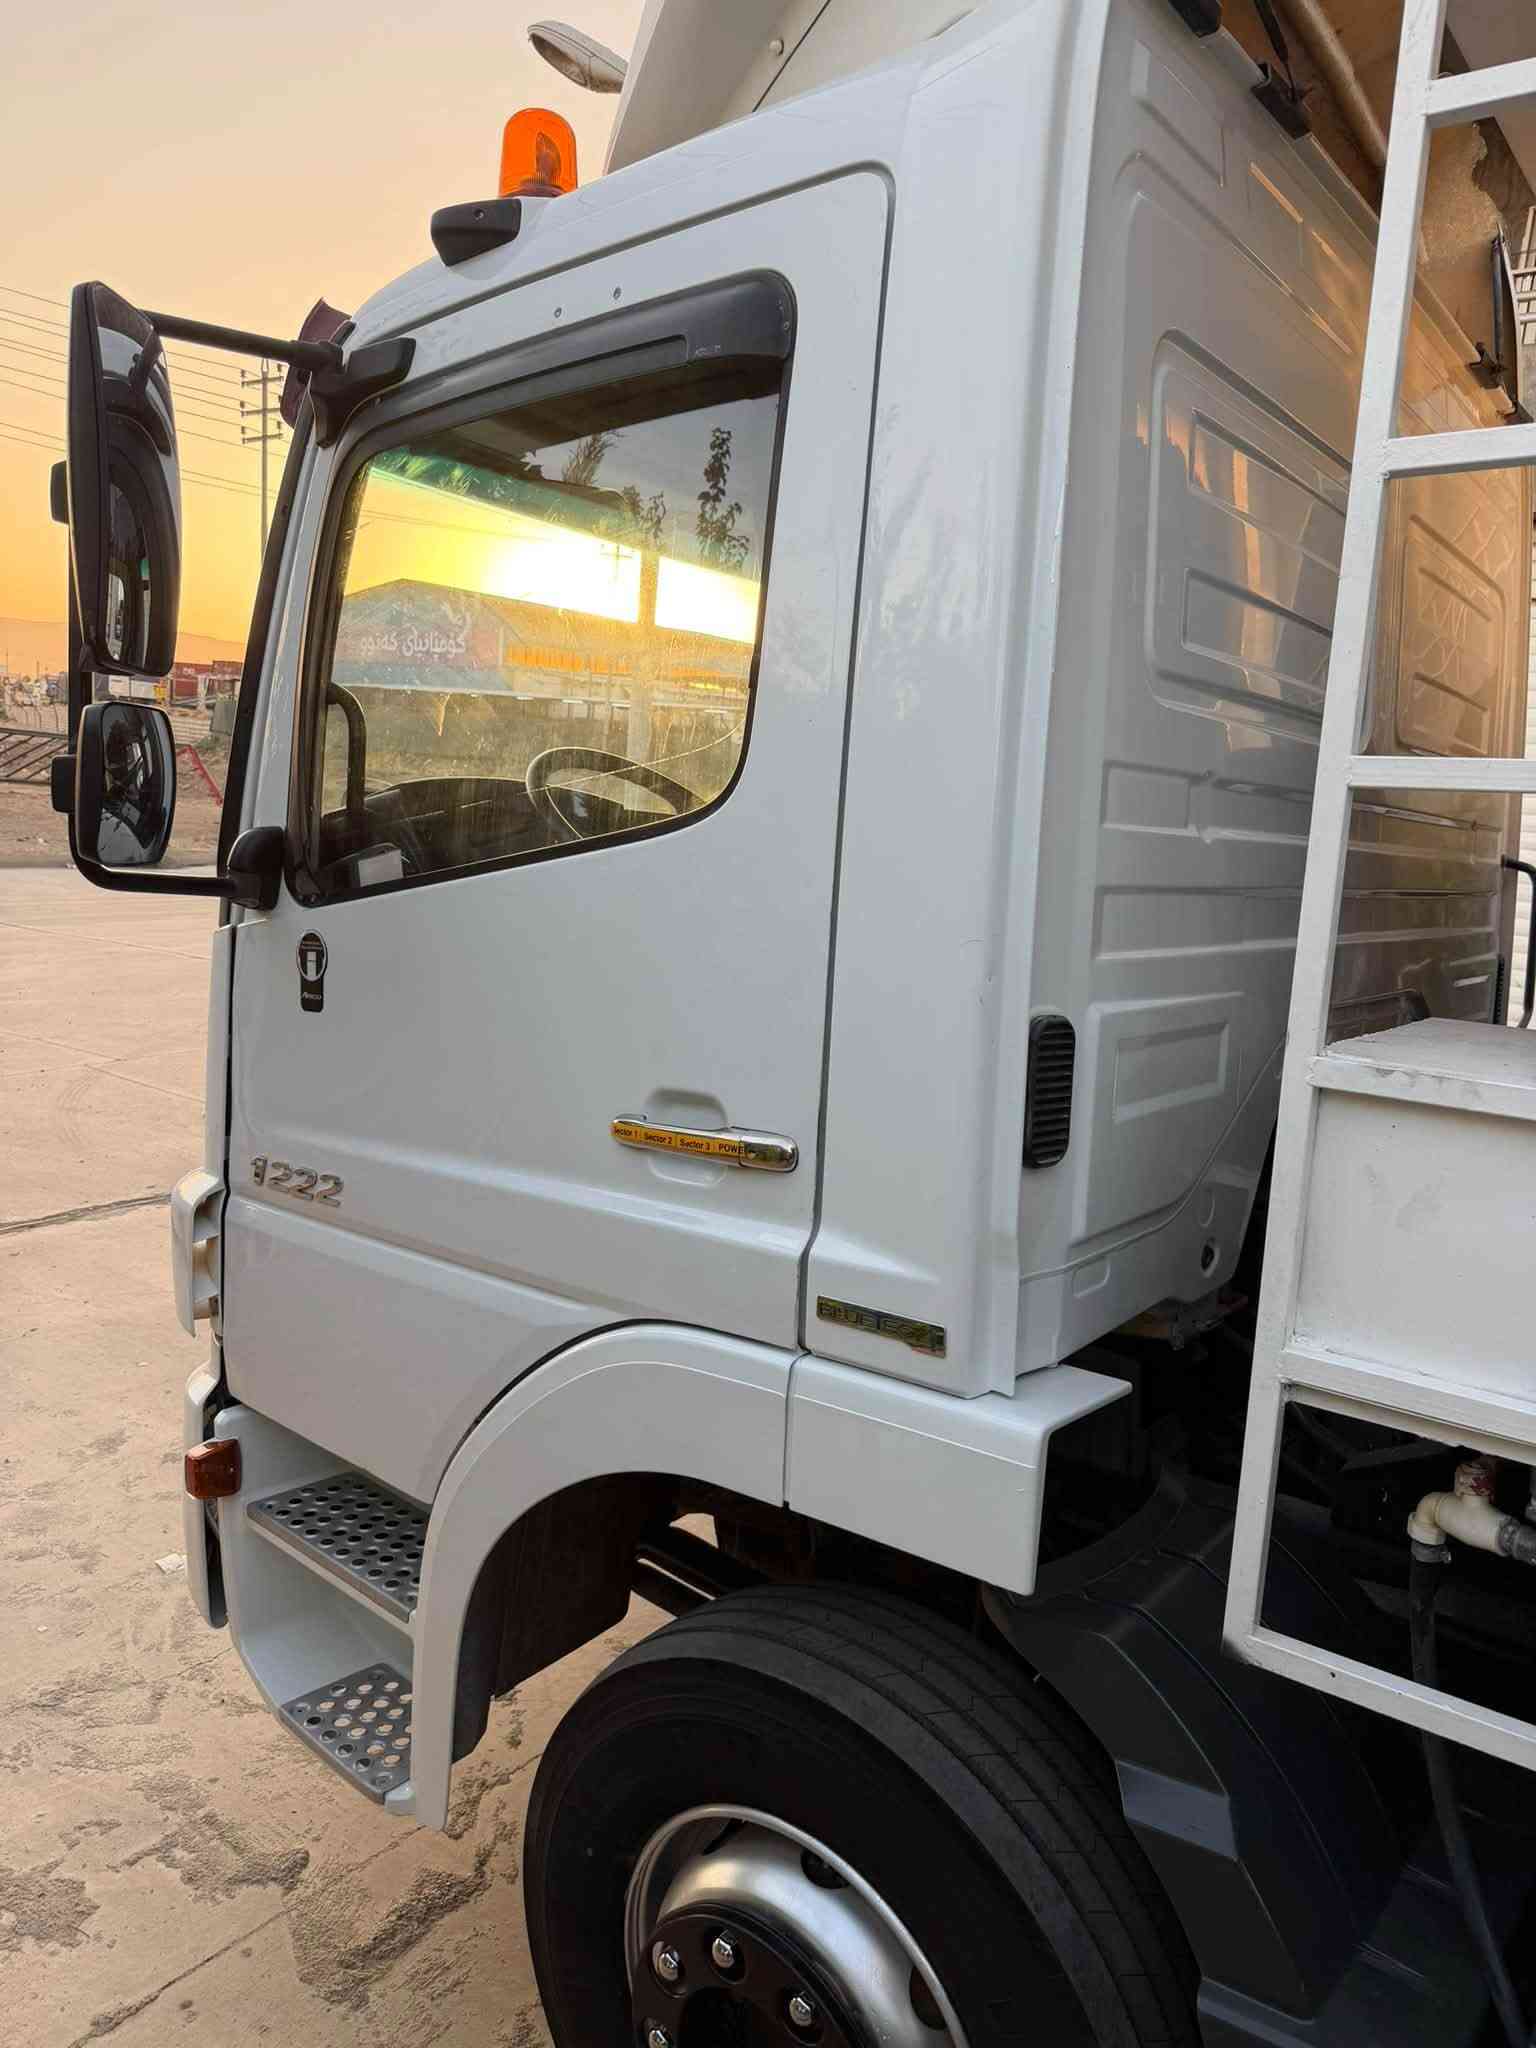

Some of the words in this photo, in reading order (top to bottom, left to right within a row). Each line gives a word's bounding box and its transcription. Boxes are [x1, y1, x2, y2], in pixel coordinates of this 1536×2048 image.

[644, 1132, 668, 1144] Sector
[679, 1139, 705, 1151] Sector
[250, 1157, 345, 1208] 1222
